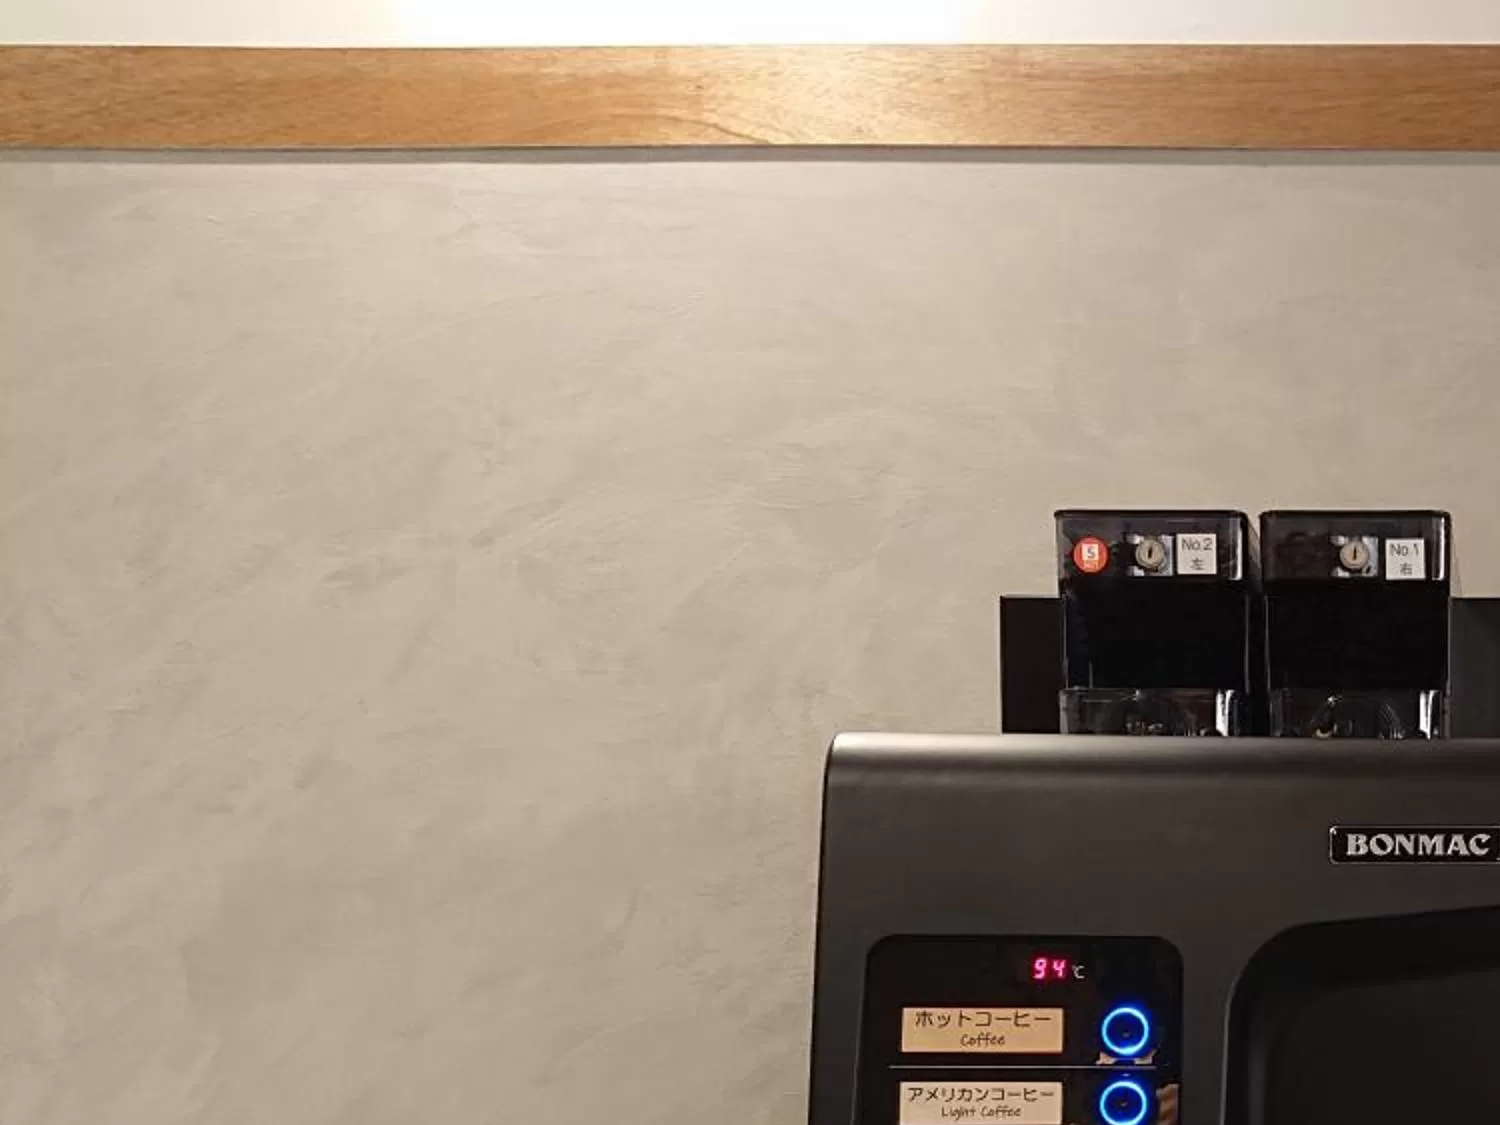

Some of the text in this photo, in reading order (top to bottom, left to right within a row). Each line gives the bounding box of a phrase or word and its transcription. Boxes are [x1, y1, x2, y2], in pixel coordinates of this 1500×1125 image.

[1345, 832, 1491, 856] BONMAC
[1033, 957, 1066, 979] 94
[914, 1010, 1052, 1028] ホットコーヒー
[959, 1032, 1006, 1047] Coffee
[907, 1087, 1055, 1102] アメリカンコーヒー
[941, 1105, 1022, 1121] Light Coffee
